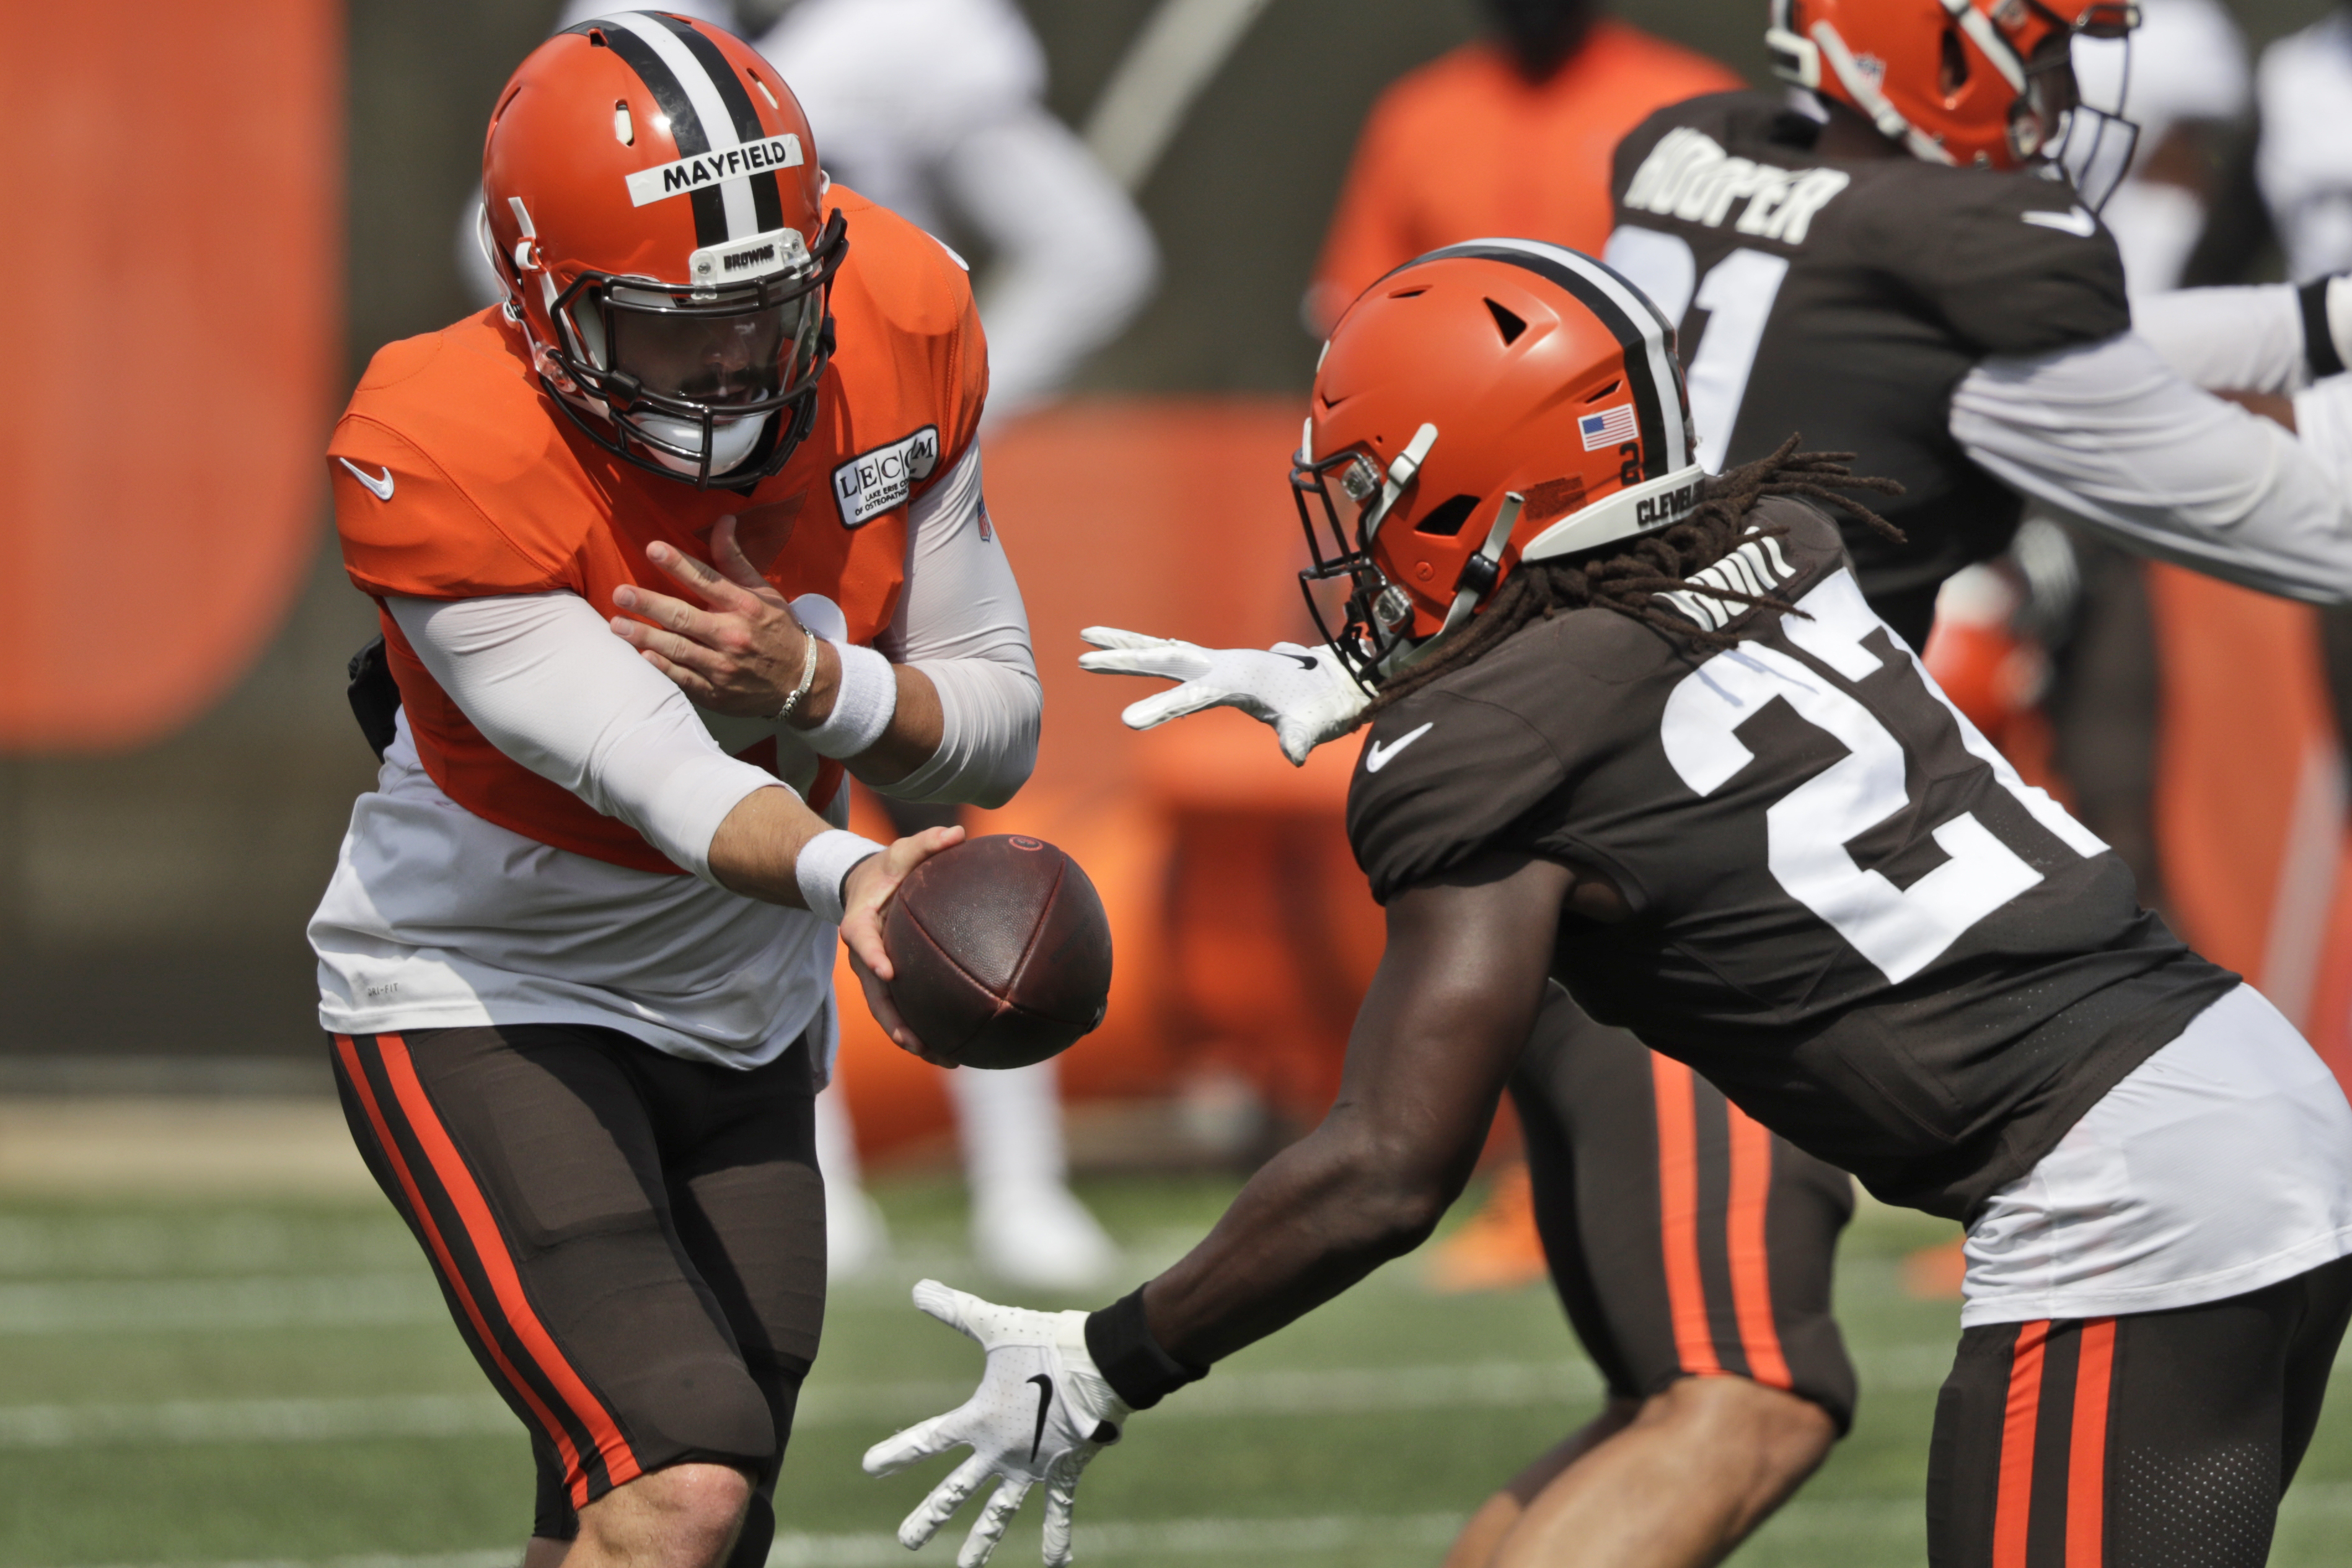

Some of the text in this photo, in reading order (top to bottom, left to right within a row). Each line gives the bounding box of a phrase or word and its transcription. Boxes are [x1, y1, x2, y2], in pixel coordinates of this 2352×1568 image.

[663, 141, 786, 192] MAYFIELD
[723, 244, 775, 272] BROWNS
[1619, 442, 1641, 486] 2
[865, 489, 881, 502] LAKE
[855, 506, 863, 516] OF
[368, 982, 399, 997] DRI-FIT
